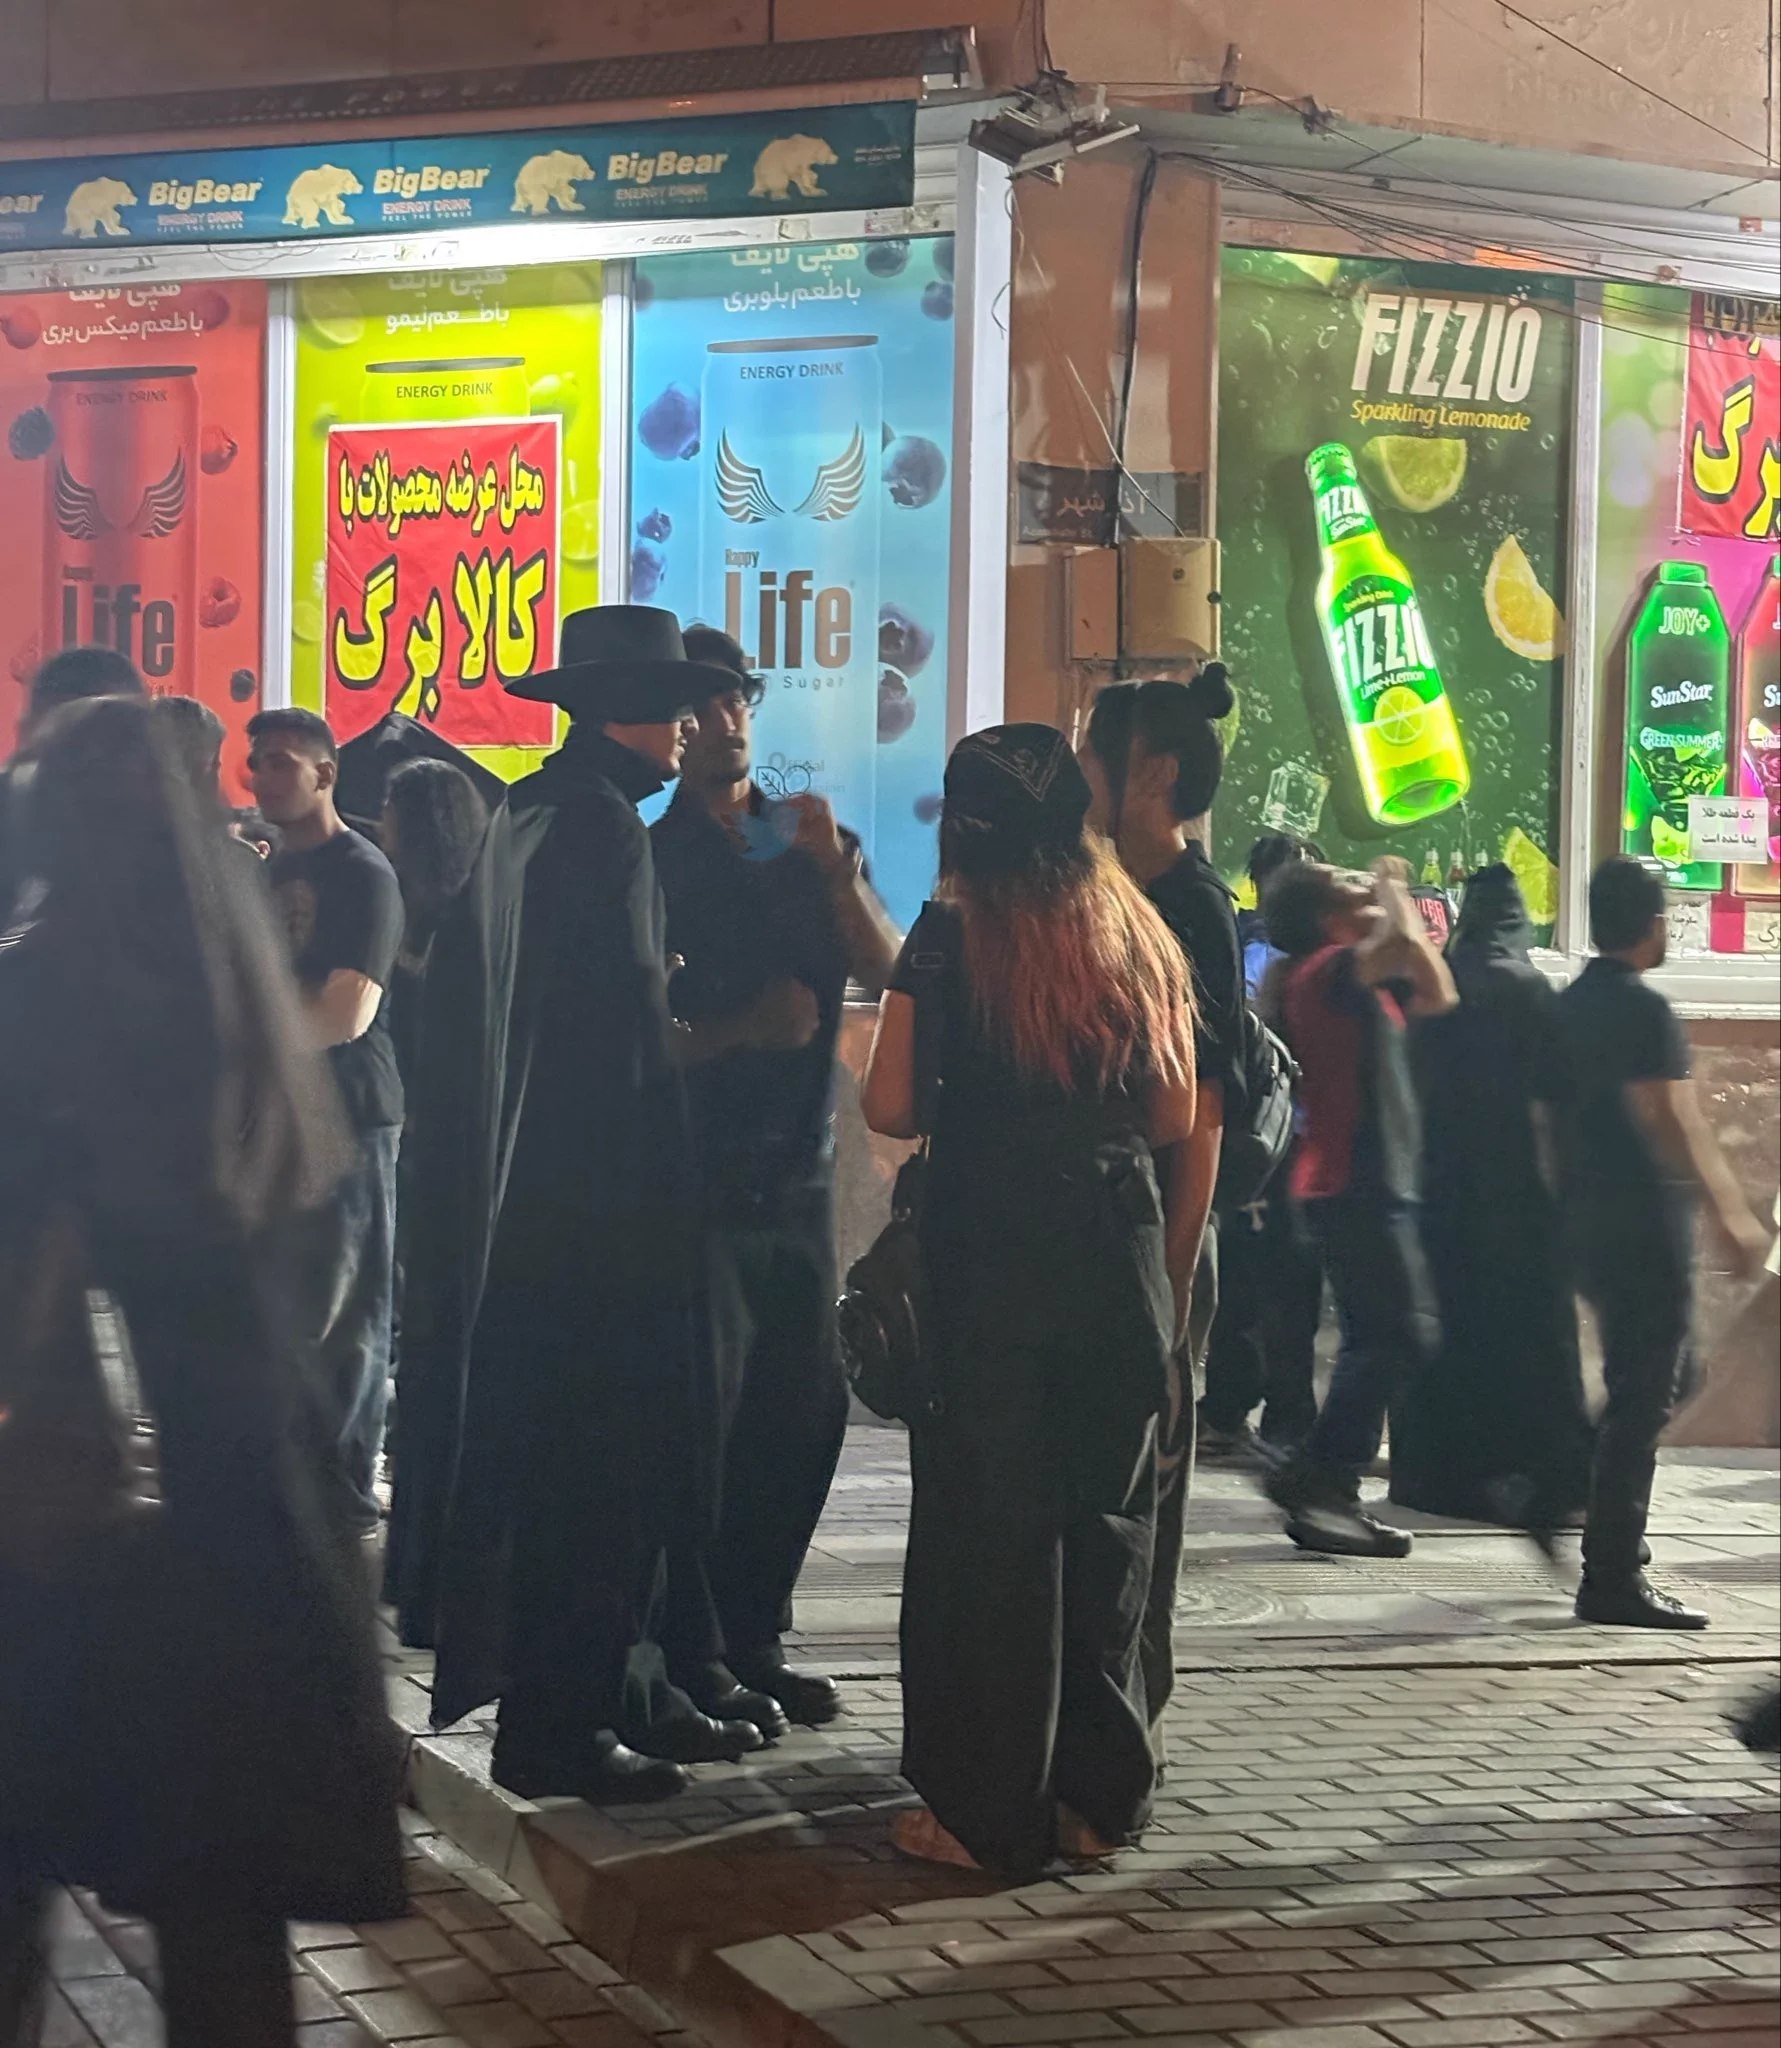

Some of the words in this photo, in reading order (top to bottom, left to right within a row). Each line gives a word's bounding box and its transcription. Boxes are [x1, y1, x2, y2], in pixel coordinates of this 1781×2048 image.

[373, 166, 490, 199] BigBear
[607, 151, 729, 184] BigBear
[148, 179, 263, 210] BigBear
[382, 201, 431, 215] ENERGY
[434, 199, 471, 212] DRINK
[797, 243, 859, 277] هپی
[1351, 293, 1542, 403] FIZZIO
[740, 365, 795, 380] ENERGY
[799, 361, 844, 377] DRINK
[396, 385, 448, 398] ENERGY
[452, 382, 493, 397] DRINK
[1350, 399, 1436, 430] Sparkling
[1438, 406, 1531, 431] Lemonade
[339, 451, 354, 538] با
[446, 450, 498, 537] عرضه
[499, 444, 545, 534] محل
[725, 549, 760, 568] Happy
[453, 548, 547, 688] کالا
[725, 569, 851, 670] Life
[1658, 606, 1711, 636] JOY+
[334, 554, 445, 722] برگ
[783, 675, 845, 691] Sugar
[1651, 681, 1714, 708] SunStar
[1641, 731, 1673, 748] GREEN
[1675, 731, 1721, 750] SUMMER
[1701, 832, 1720, 843] است
